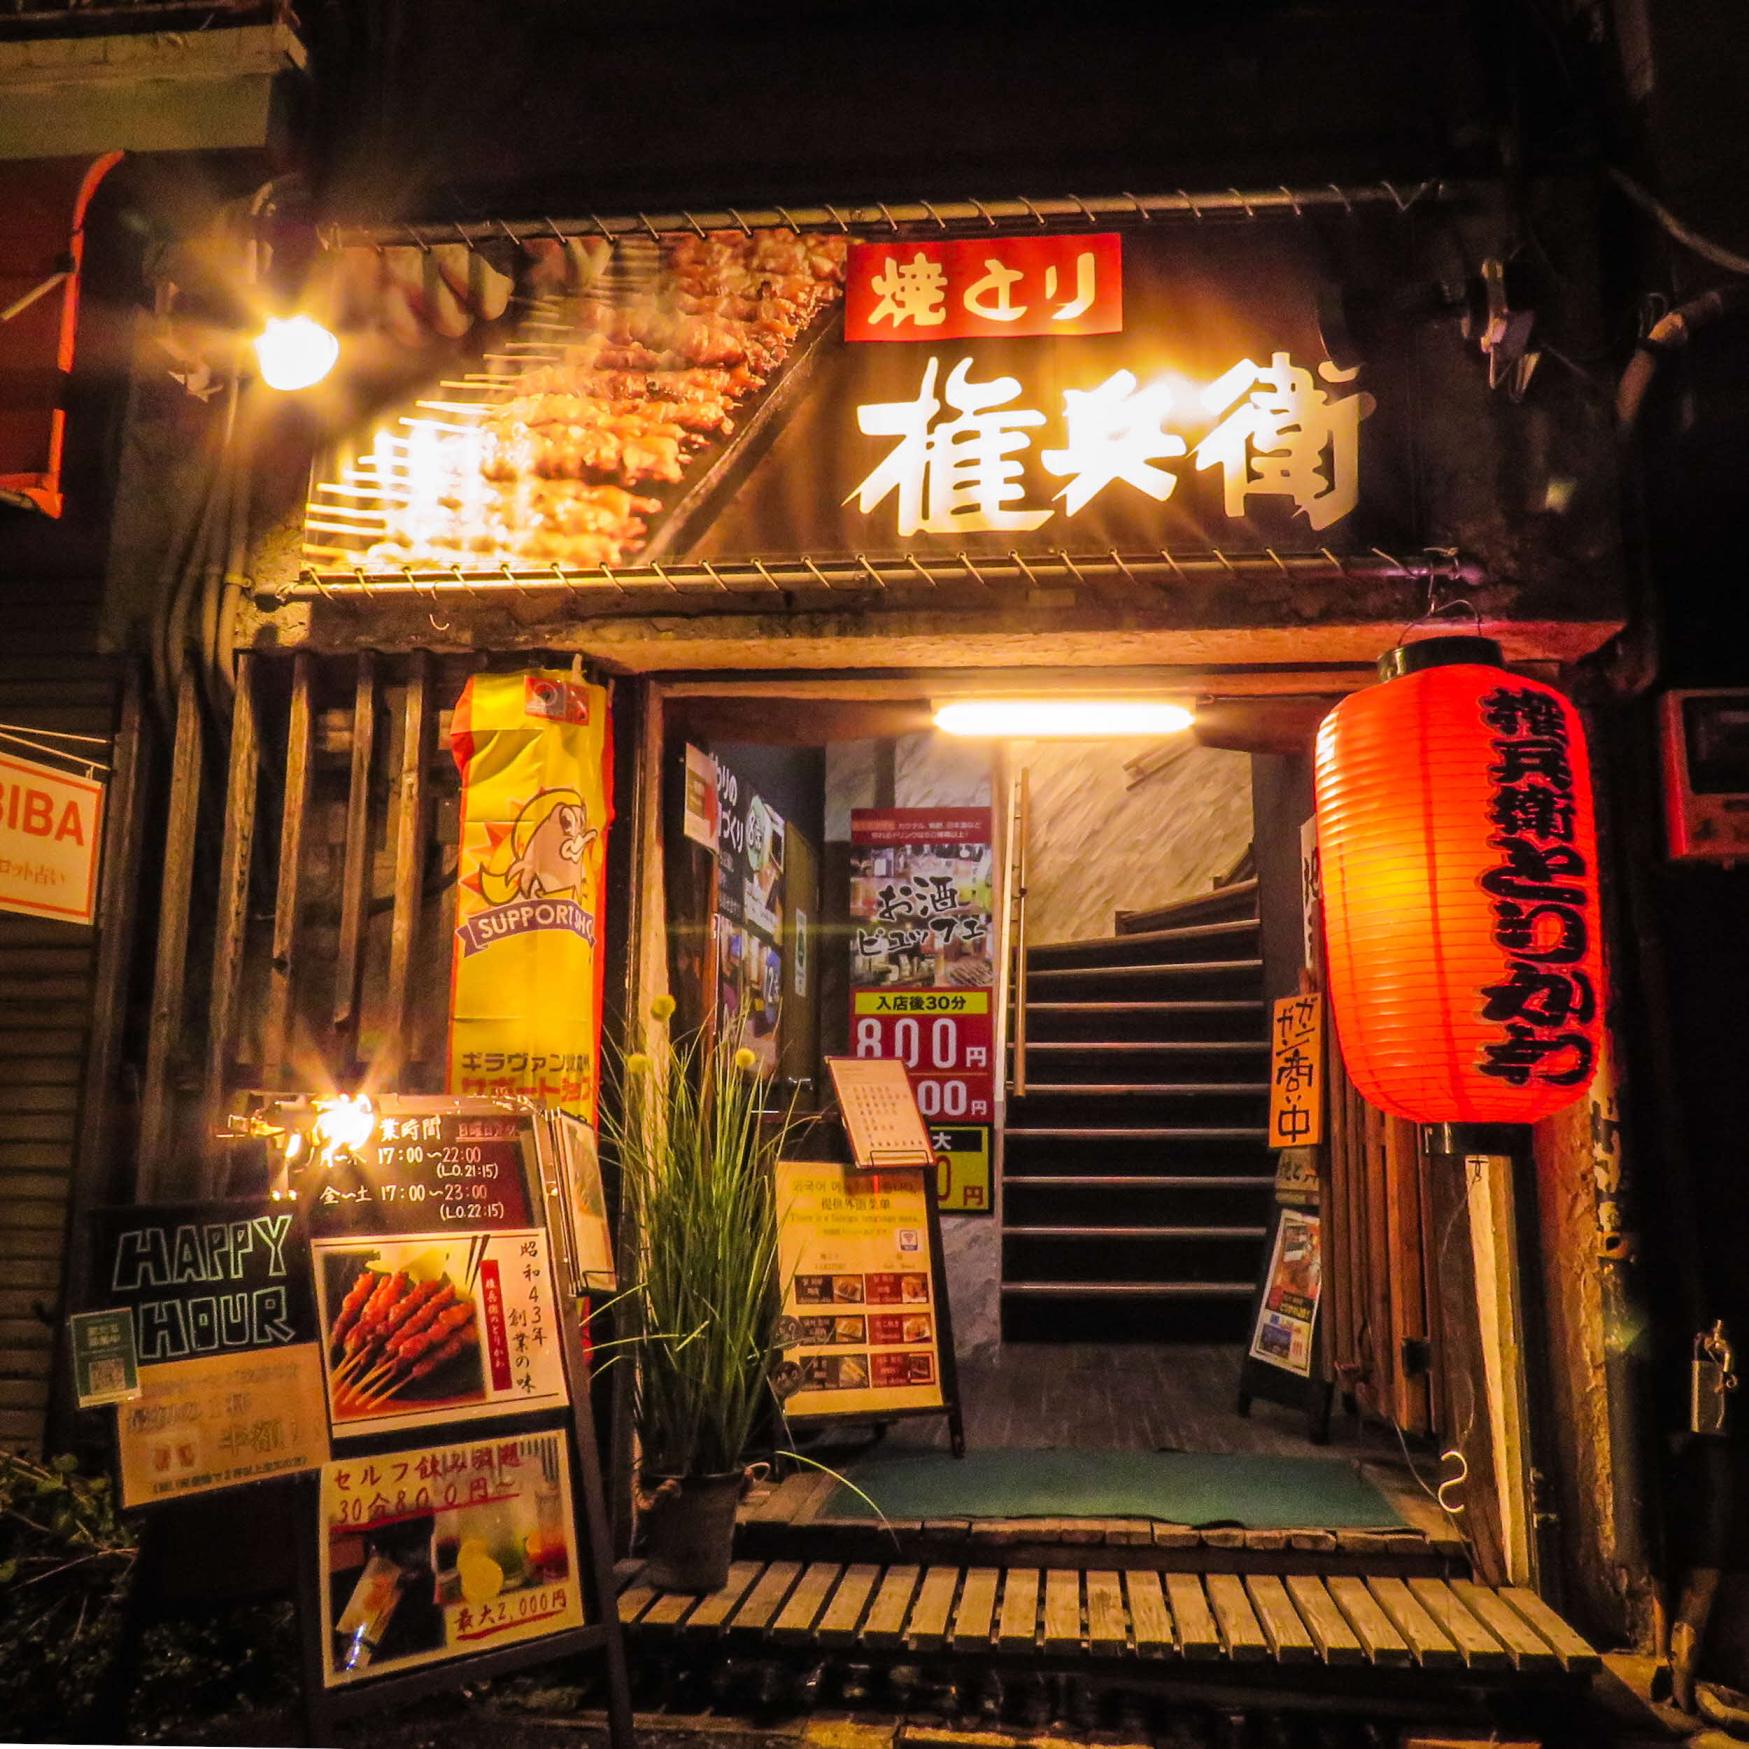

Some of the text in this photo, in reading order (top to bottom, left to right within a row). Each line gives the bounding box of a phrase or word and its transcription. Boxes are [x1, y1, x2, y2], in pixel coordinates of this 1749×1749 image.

[868, 251, 1095, 328] 焼とり
[0, 784, 84, 847] IBA
[878, 876, 960, 921] お酒
[857, 917, 988, 957] ビュッフェ
[876, 995, 967, 1011] 入店後30分
[917, 1080, 987, 1117] 00円
[379, 1114, 442, 1142] 業時間
[932, 1131, 952, 1149] 大
[937, 1155, 984, 1206] 0円
[112, 1214, 292, 1291] HAPPY
[521, 1241, 547, 1346] 昭和43年
[139, 1286, 295, 1359] HOUR
[509, 1310, 536, 1393] 創業の味
[334, 1442, 523, 1489] セルフ飲み放題
[454, 1588, 567, 1631] 最大2,000円
